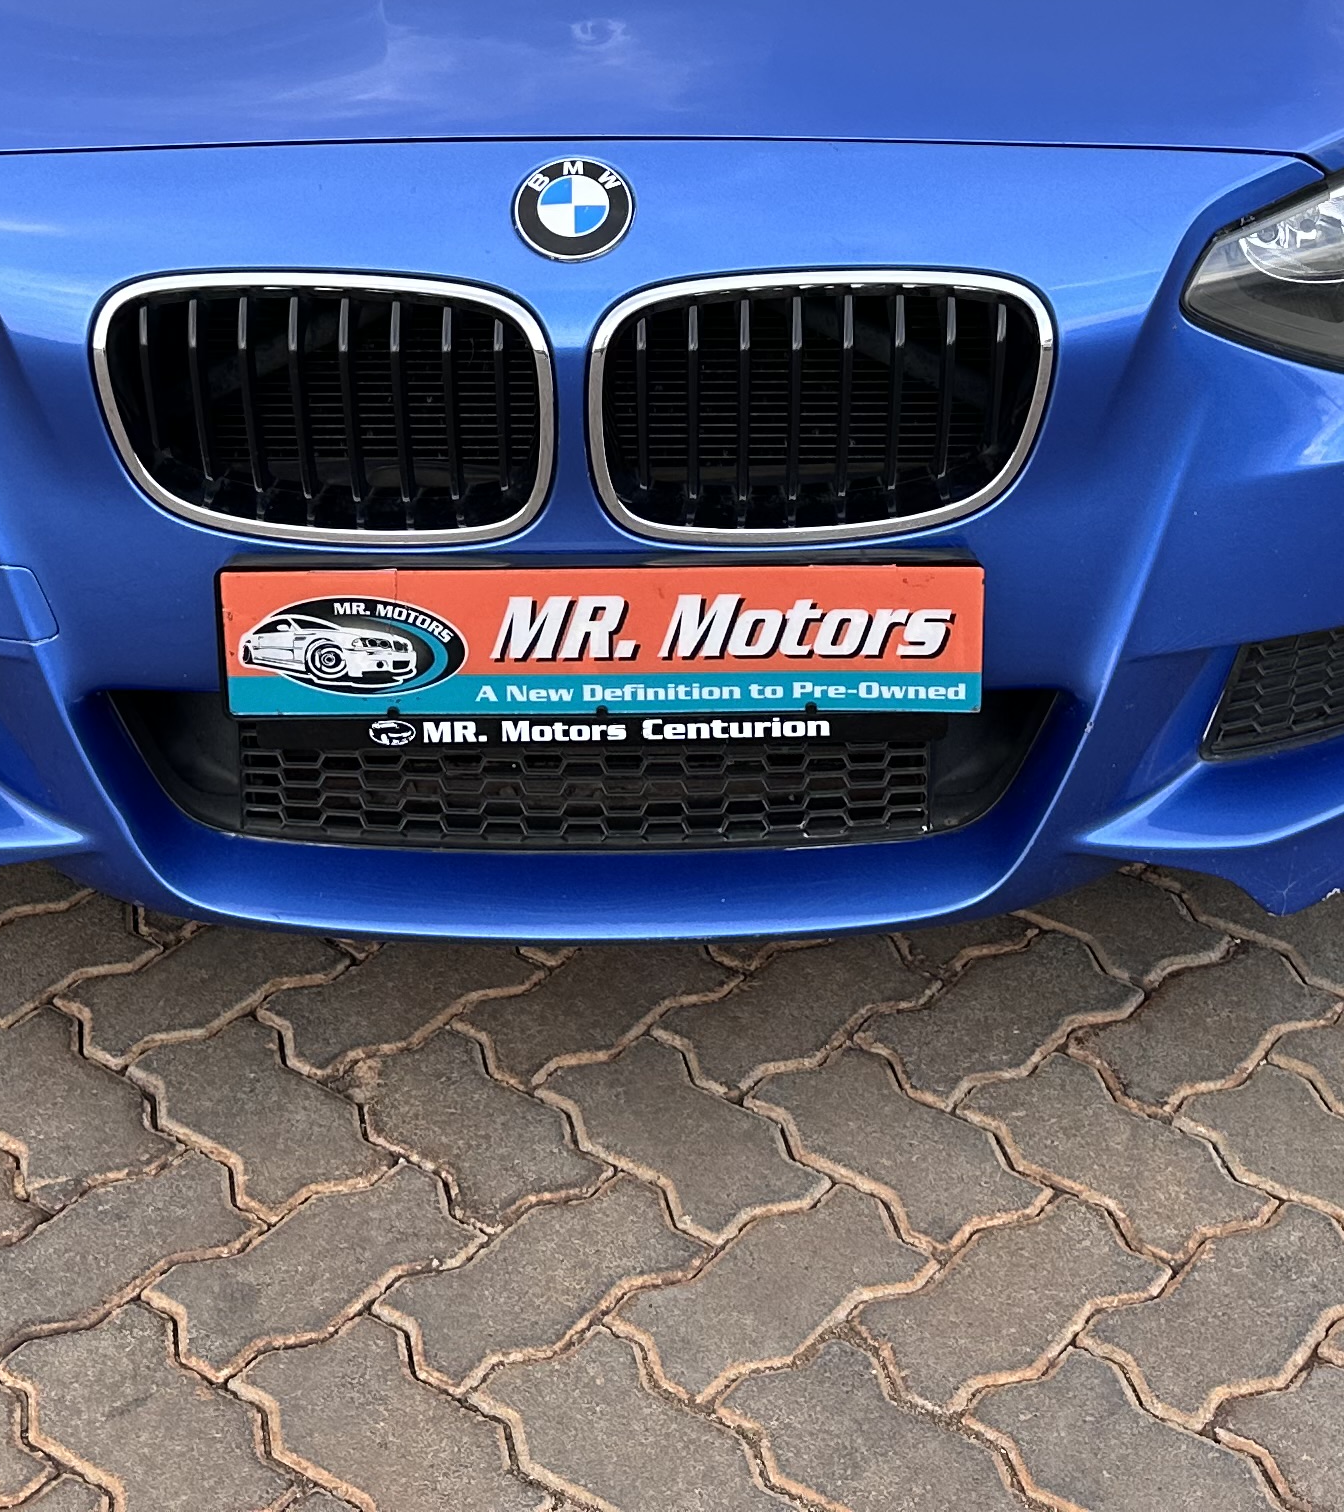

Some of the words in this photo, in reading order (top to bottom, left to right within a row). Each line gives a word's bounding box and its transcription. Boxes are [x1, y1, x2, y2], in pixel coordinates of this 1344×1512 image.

[527, 160, 621, 192] BMW
[333, 602, 370, 616] MR.
[376, 603, 454, 643] MOTORS
[489, 595, 640, 662] MR.
[657, 593, 956, 660] Motors
[475, 685, 498, 702] A
[507, 684, 574, 702] New
[583, 683, 741, 702] Definition
[749, 683, 783, 699] to
[793, 681, 966, 701] Pre-Owned
[423, 721, 487, 743] MR.
[502, 720, 626, 742] Motors
[643, 717, 830, 740] Centurion
